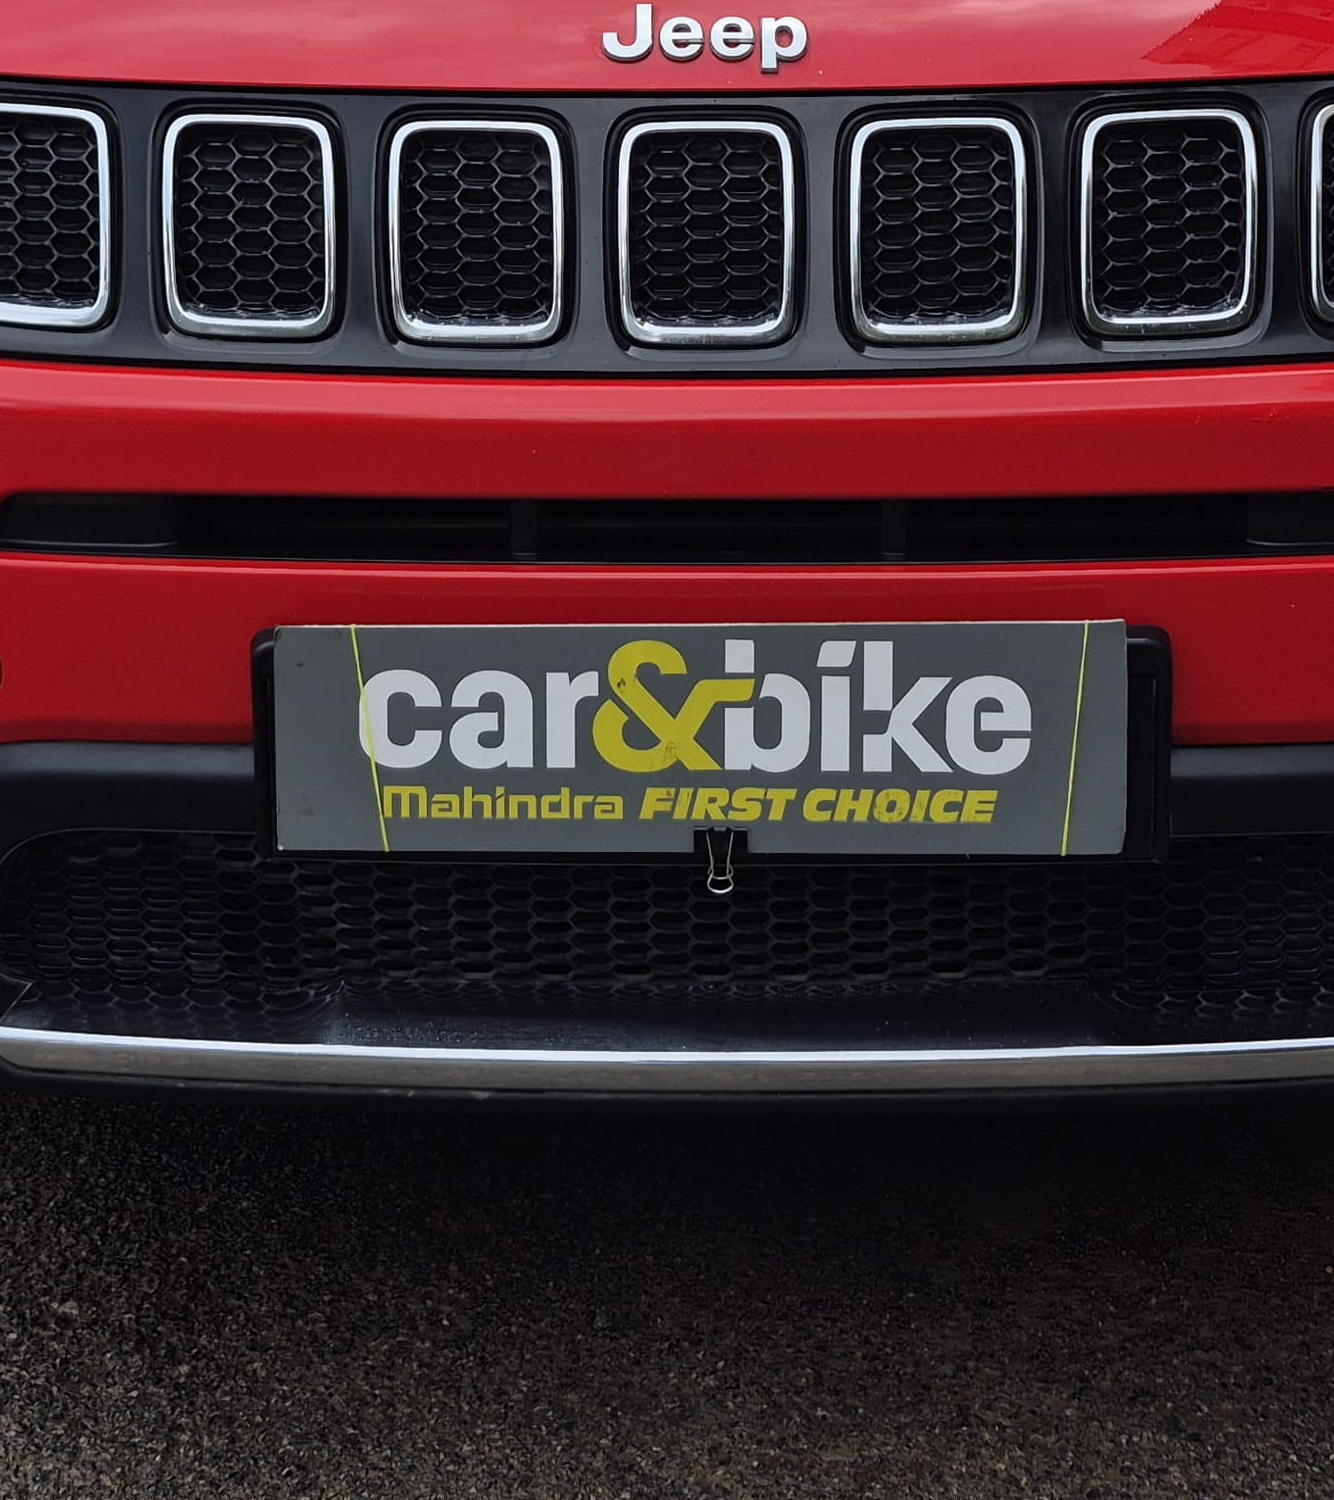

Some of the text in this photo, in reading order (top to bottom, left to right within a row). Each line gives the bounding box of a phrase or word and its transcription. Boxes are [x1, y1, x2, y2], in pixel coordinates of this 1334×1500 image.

[602, 3, 810, 74] Jeep
[359, 639, 1032, 775] car&bike
[383, 785, 998, 823] Mahindra FIRST CHOICE
